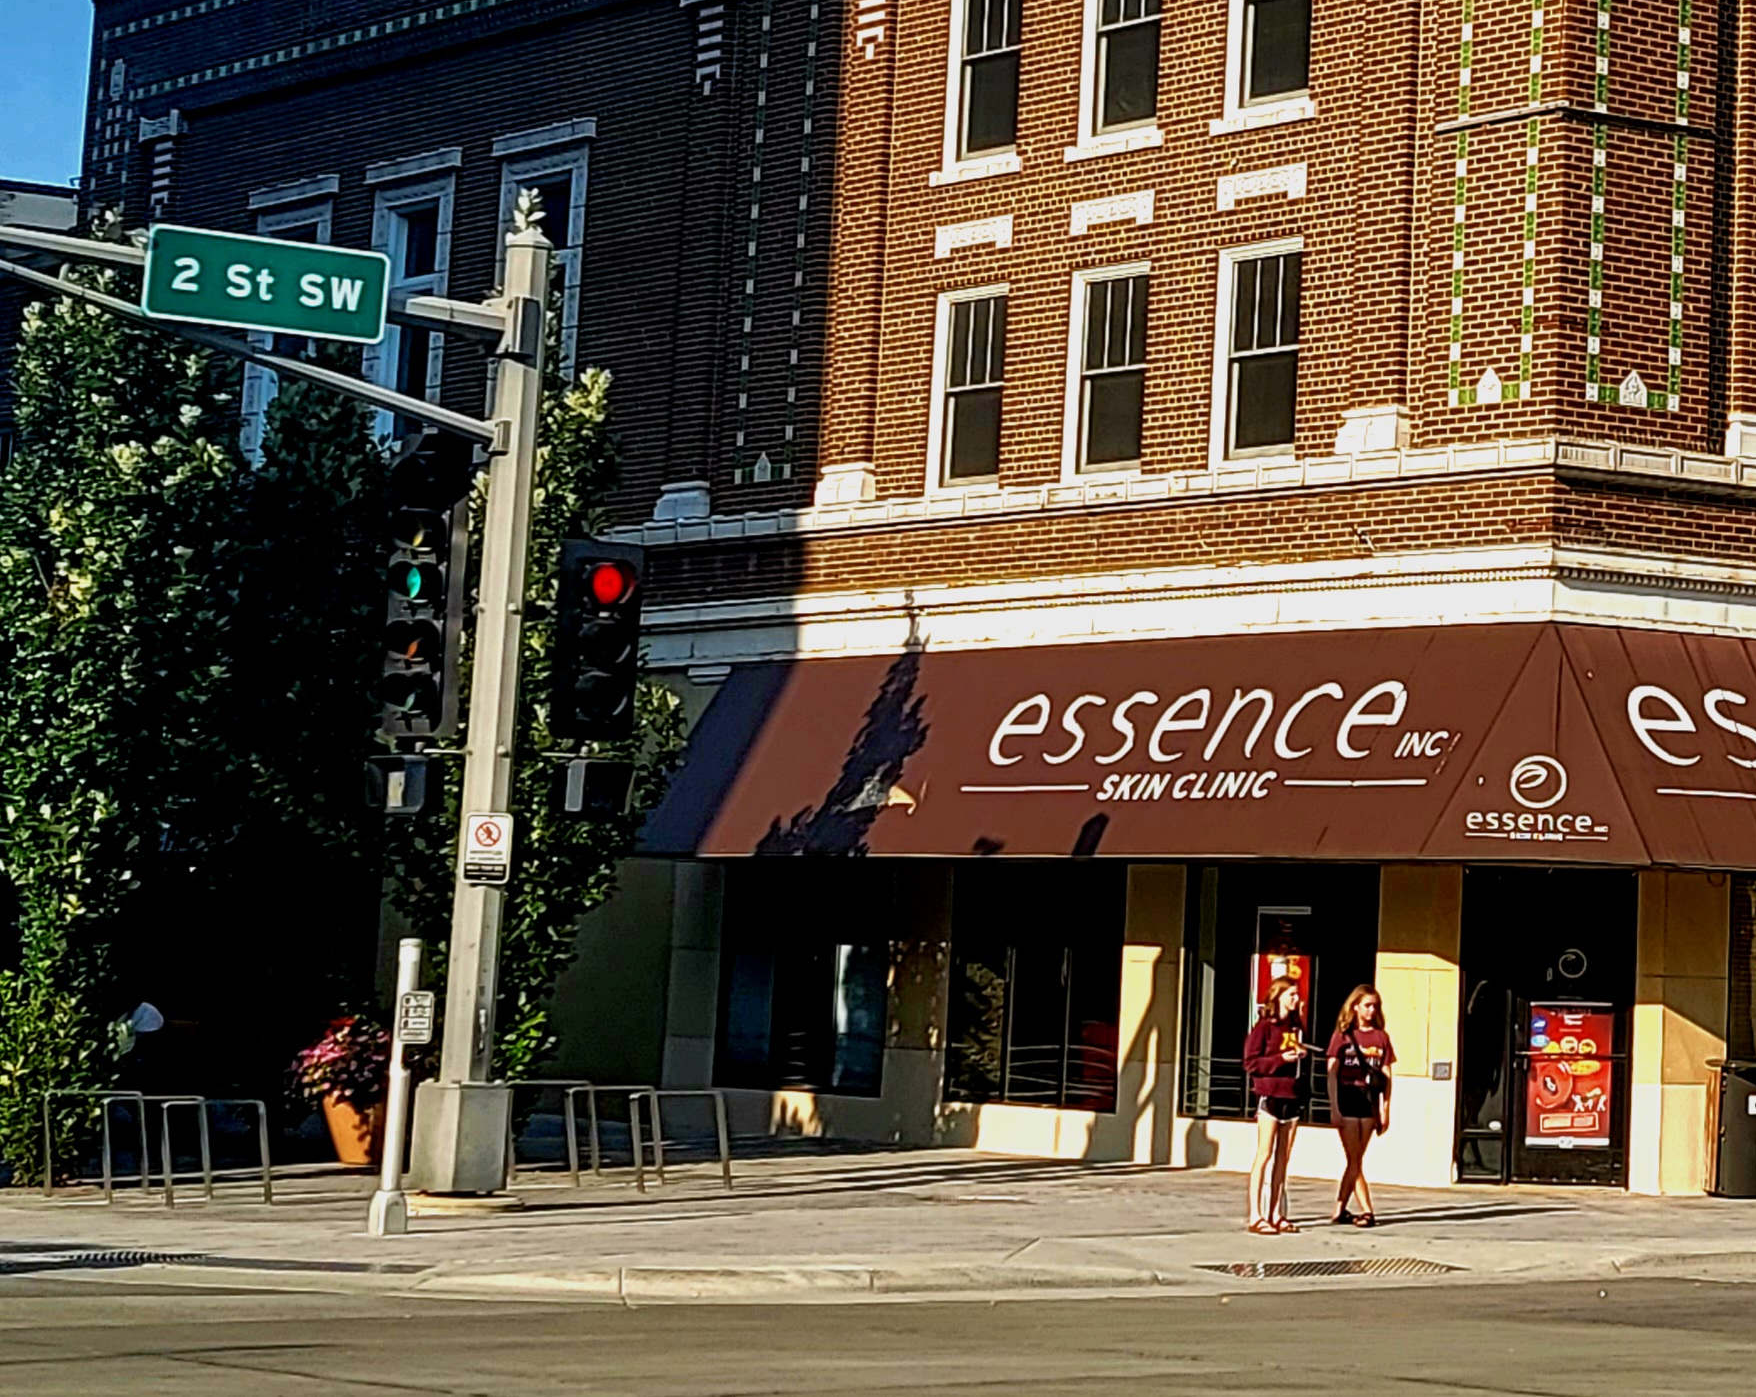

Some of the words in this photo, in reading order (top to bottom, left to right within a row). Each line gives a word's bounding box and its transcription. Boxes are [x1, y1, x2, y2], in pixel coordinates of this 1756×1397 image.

[171, 257, 200, 292] 2
[226, 263, 274, 301] St
[299, 273, 364, 312] SW
[989, 680, 1407, 765] essence
[1395, 731, 1448, 757] INC
[1096, 773, 1171, 801] SKIN
[1173, 770, 1278, 799] CLINIC
[1466, 811, 1593, 833] essence
